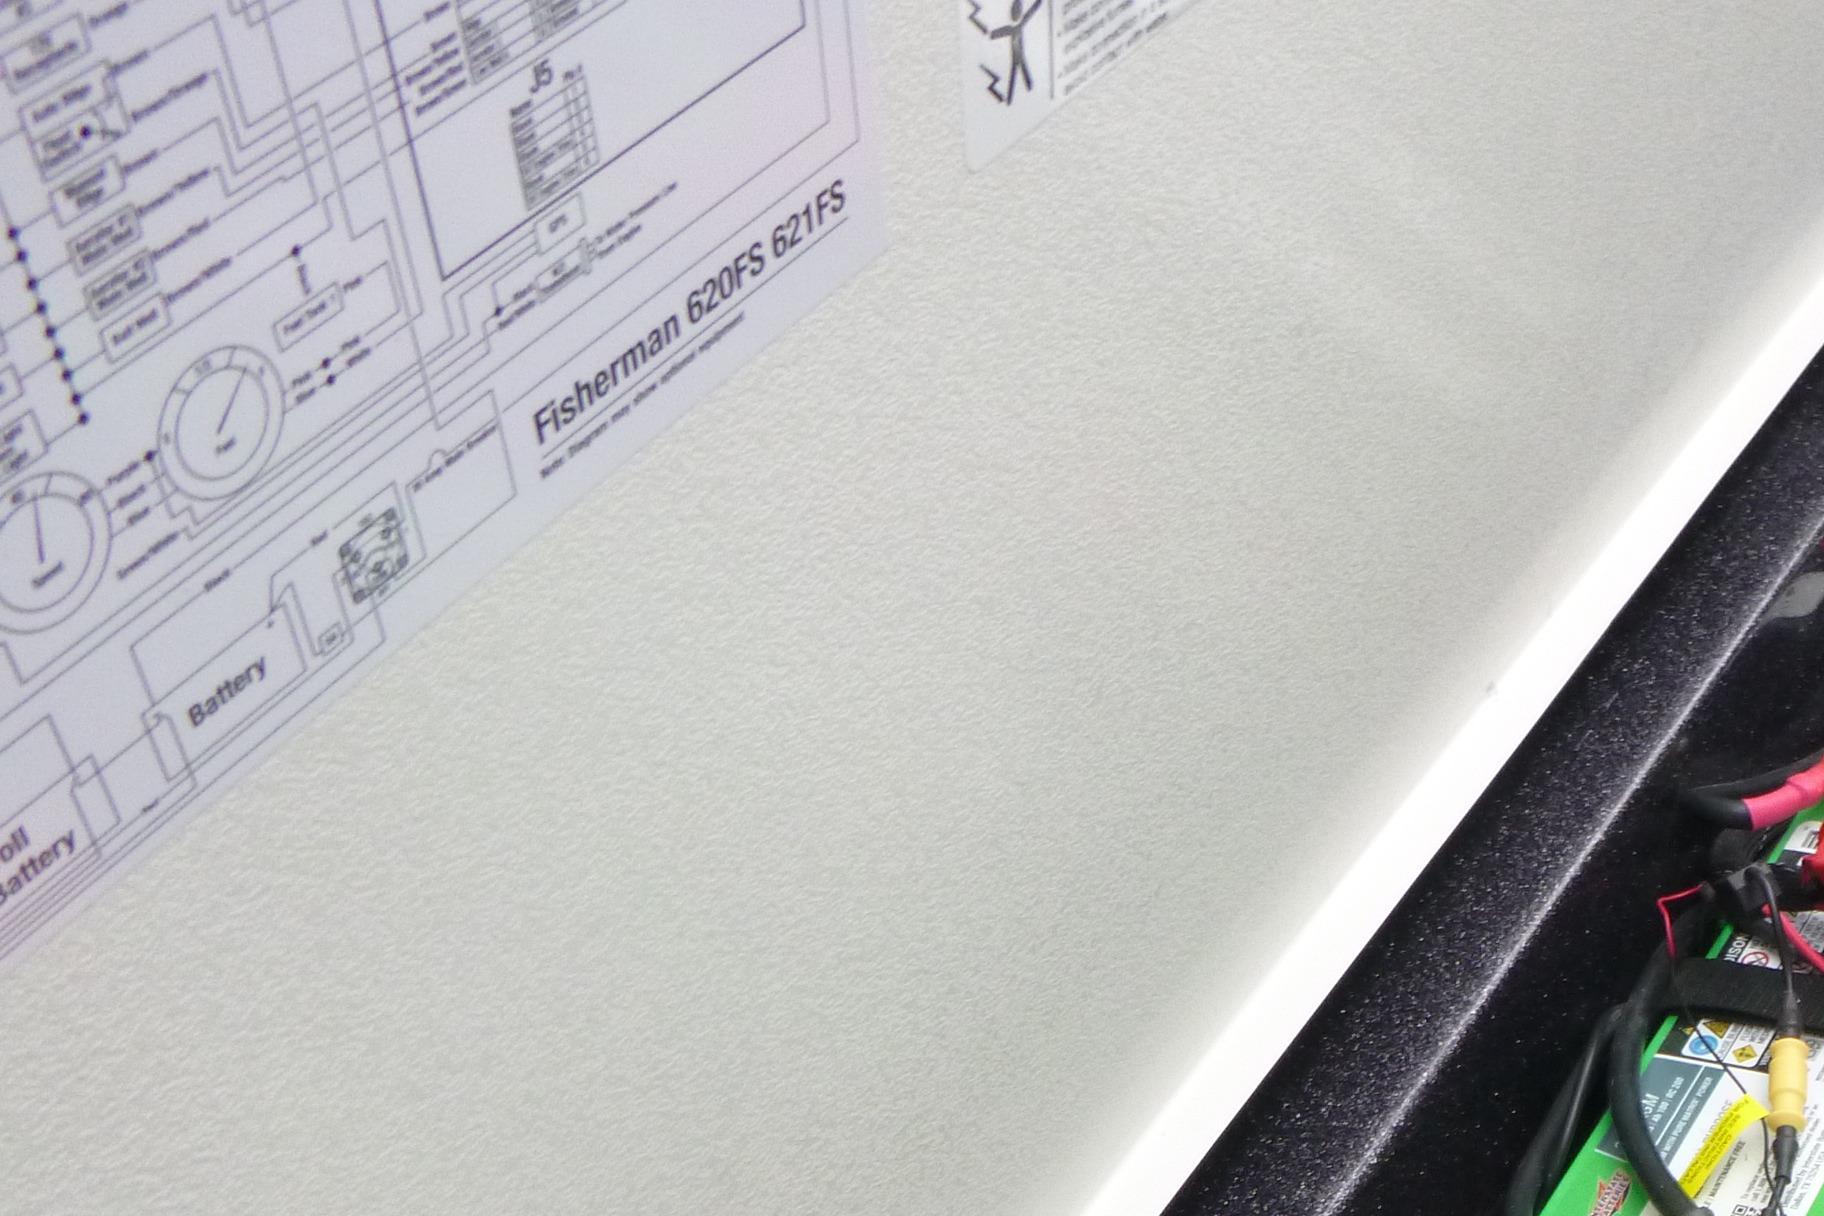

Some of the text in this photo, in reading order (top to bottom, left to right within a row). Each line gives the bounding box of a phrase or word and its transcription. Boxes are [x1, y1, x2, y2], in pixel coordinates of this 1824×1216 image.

[535, 180, 844, 442] Fisherman 620FS 621FS
[188, 658, 265, 726] Battery
